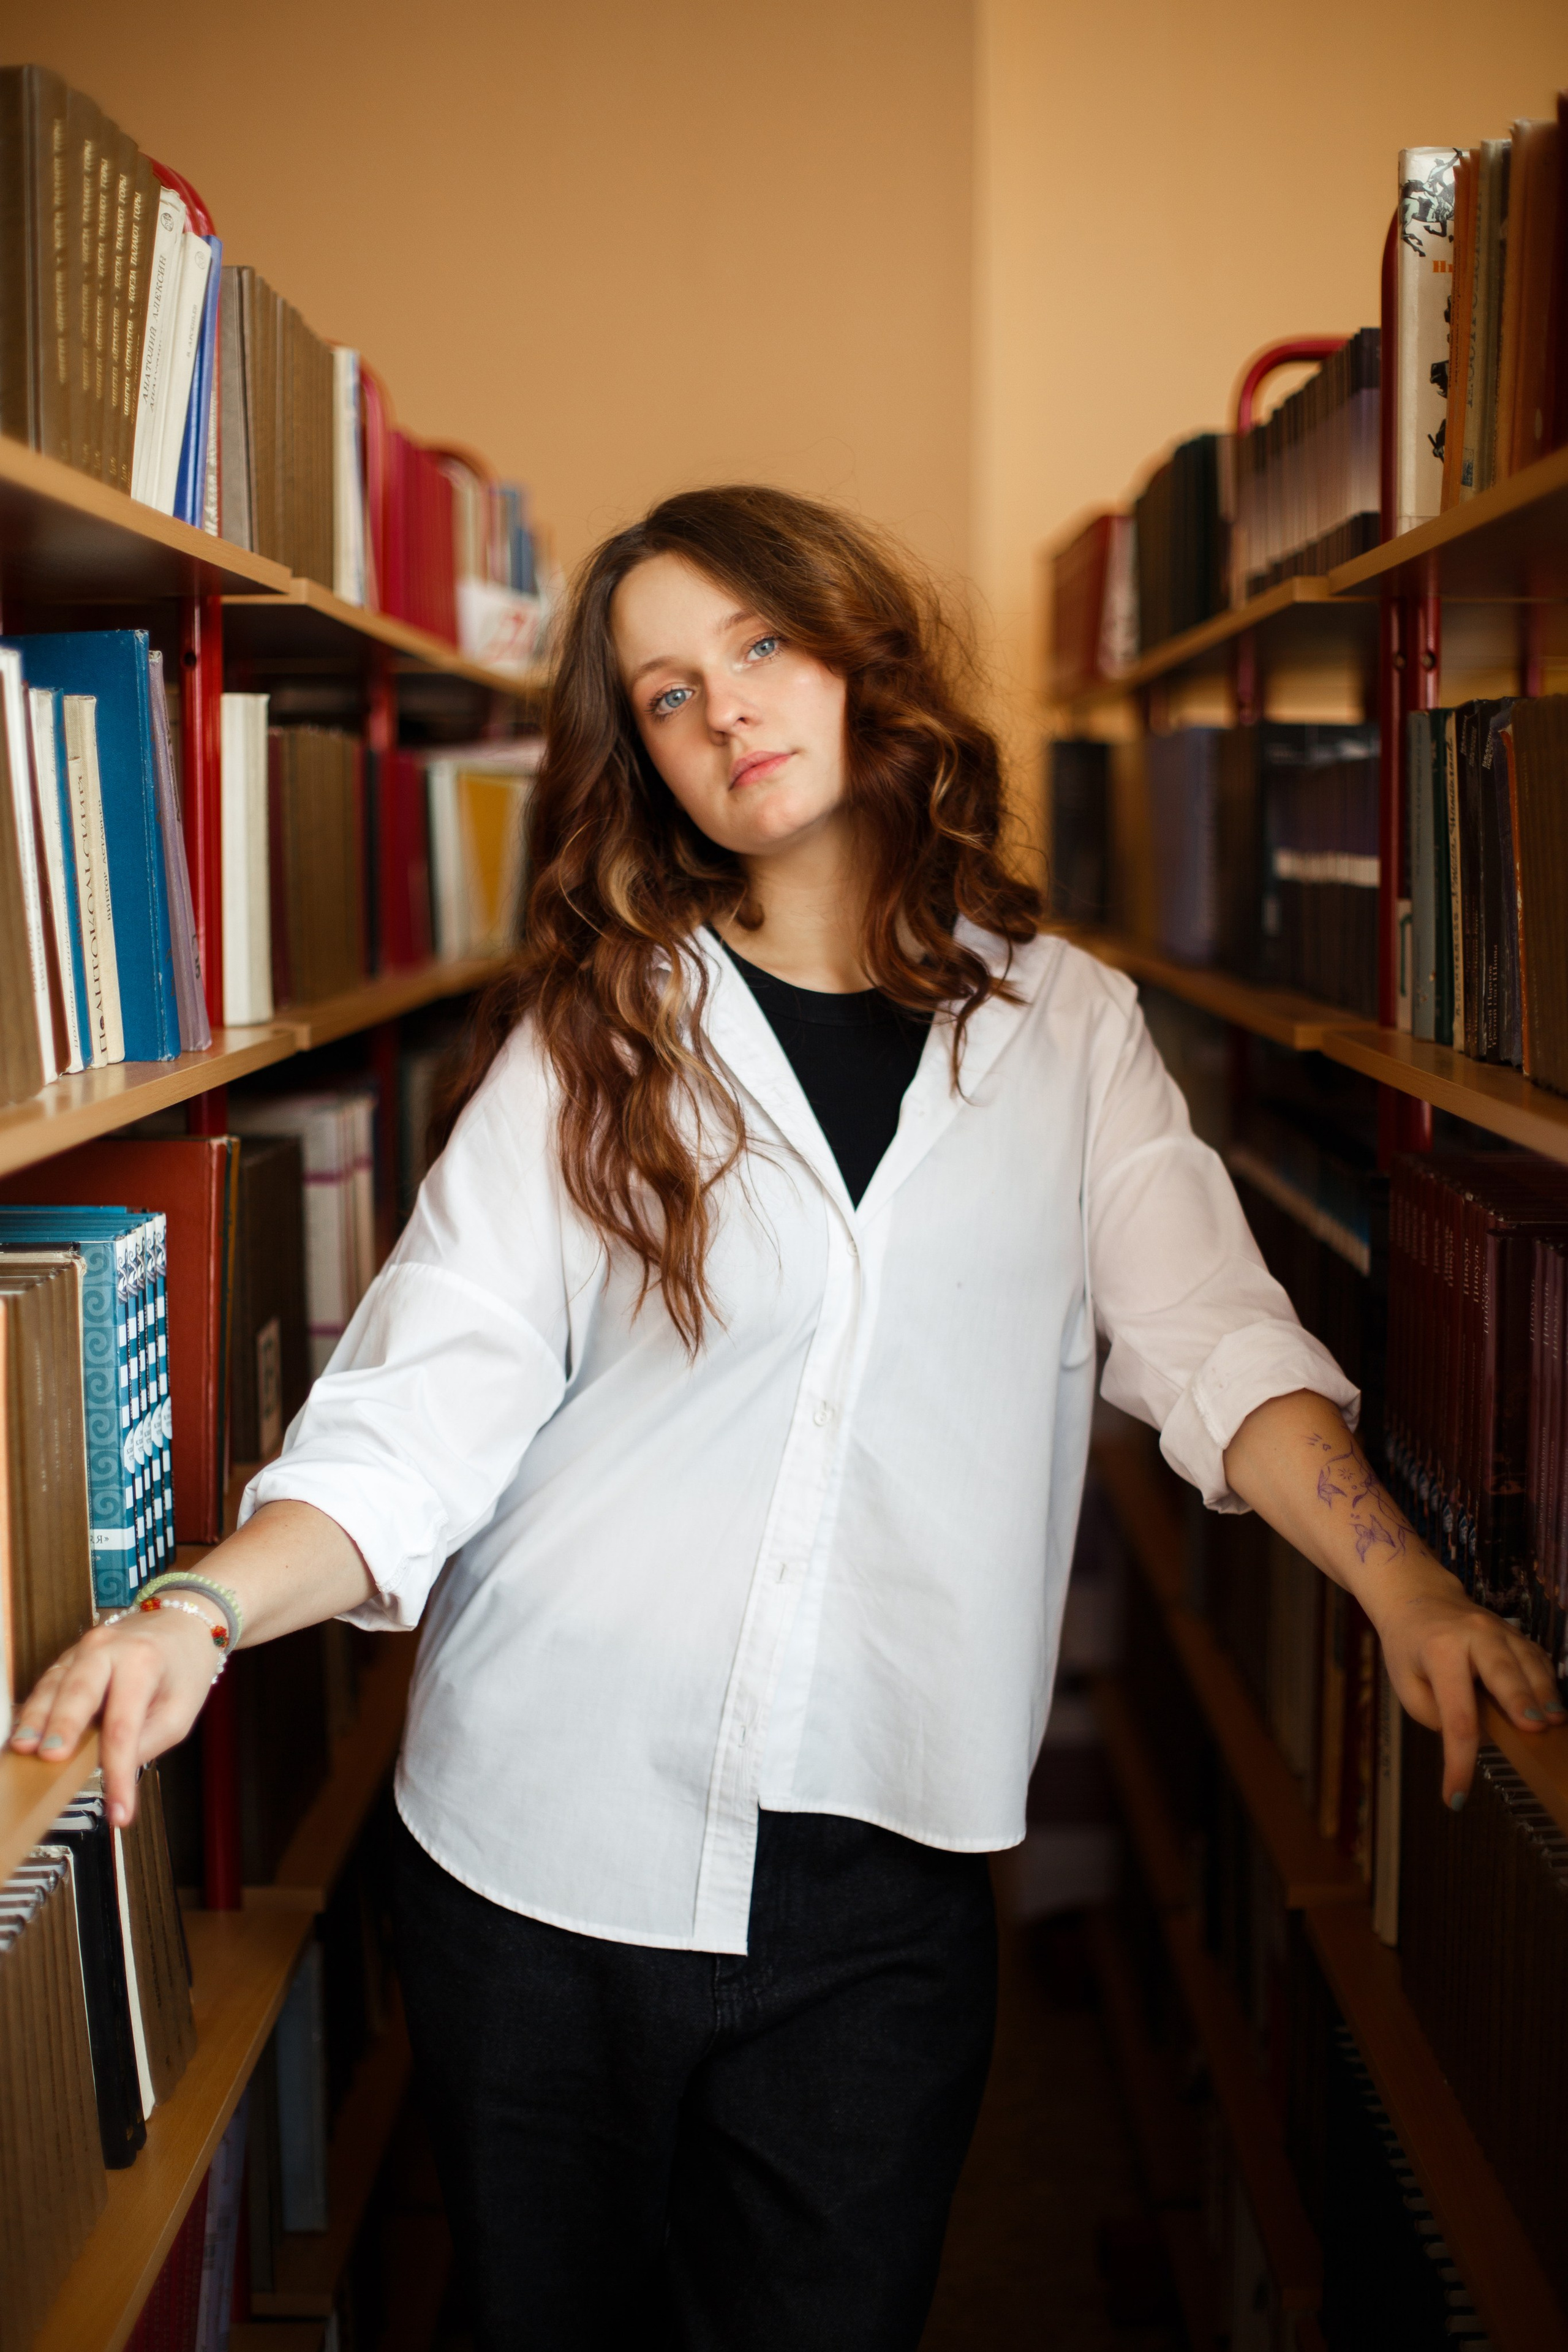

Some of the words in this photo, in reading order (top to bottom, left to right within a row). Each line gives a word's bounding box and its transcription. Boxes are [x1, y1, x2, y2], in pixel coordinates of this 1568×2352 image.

[132, 192, 142, 220] ГОРЫ
[129, 223, 140, 266] ПАДАЮТ
[127, 270, 137, 302] КОГДА
[125, 320, 135, 372] АЙТМАТОВ
[141, 326, 157, 403] АНАТОЛИЙ
[151, 253, 167, 322] АЛЕКСИН
